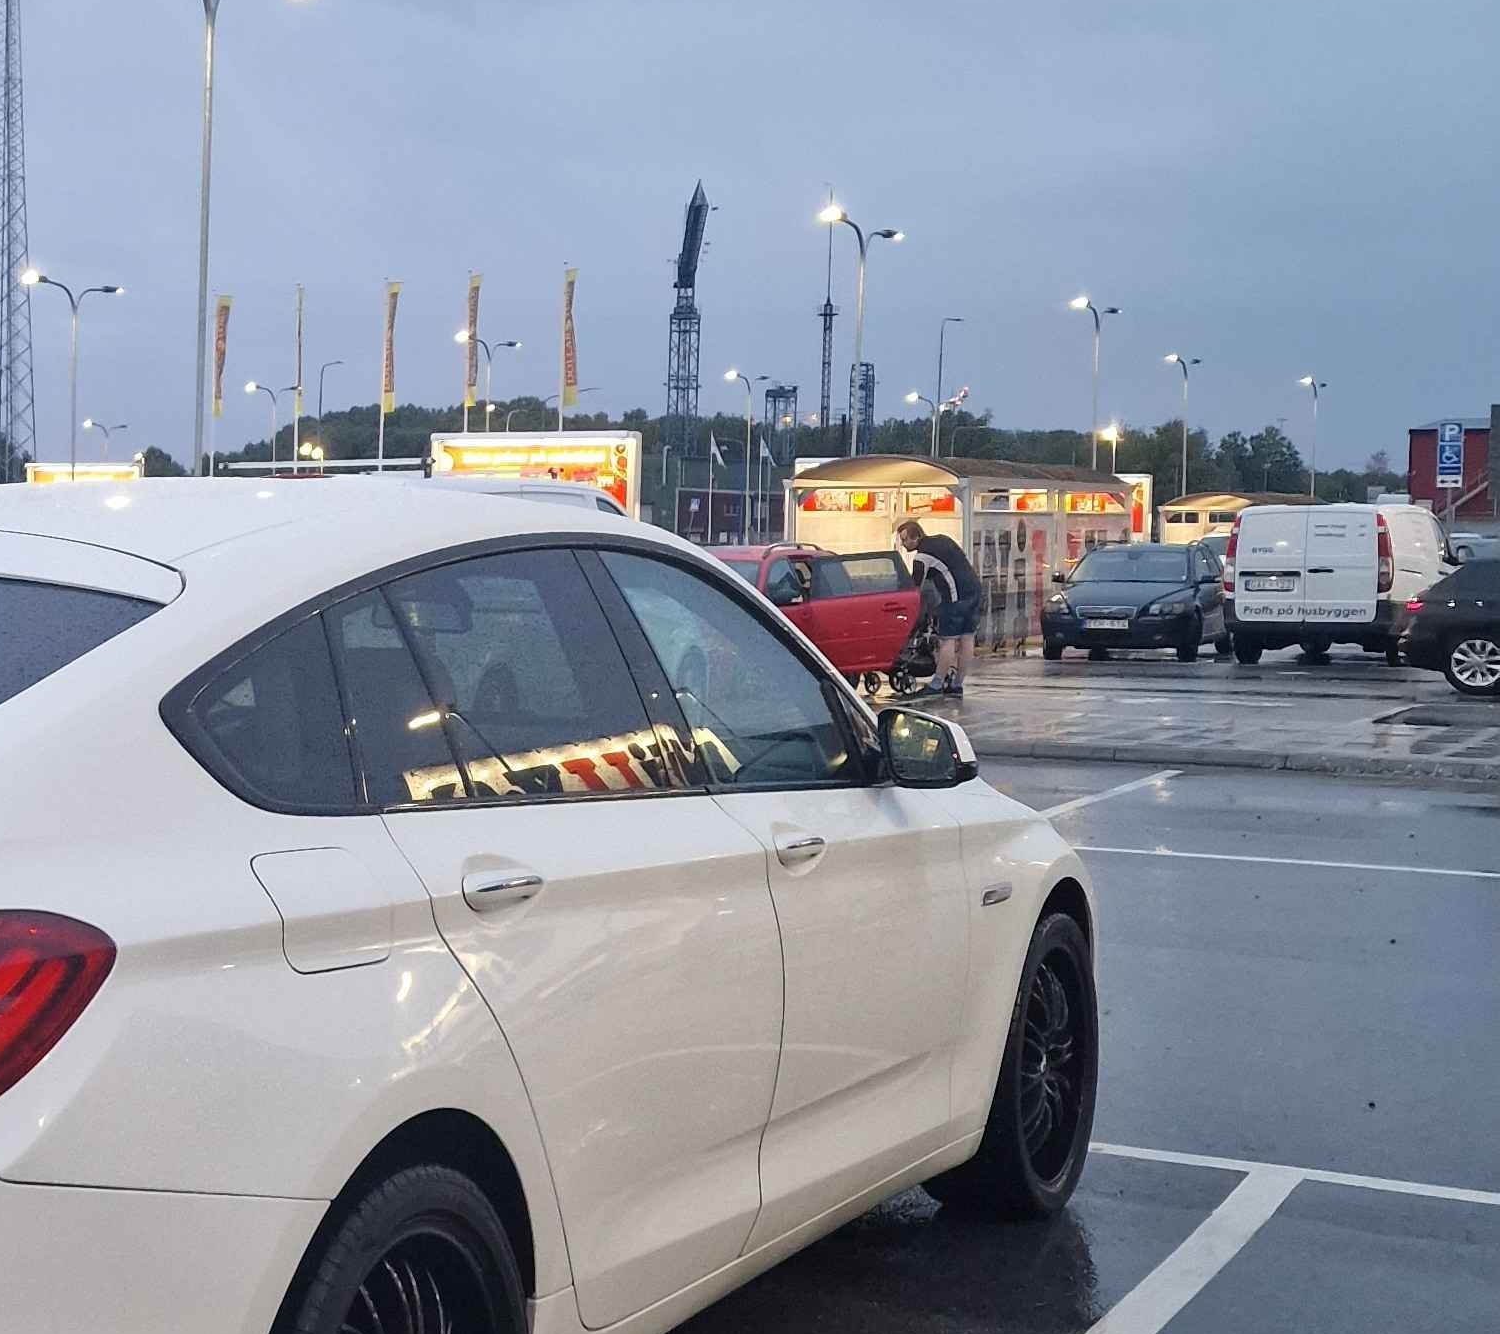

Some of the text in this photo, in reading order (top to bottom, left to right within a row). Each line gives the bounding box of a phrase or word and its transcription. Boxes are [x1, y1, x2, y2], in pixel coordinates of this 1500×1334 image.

[1445, 424, 1460, 442] P
[1243, 605, 1367, 619] Proffs på husbyggen
